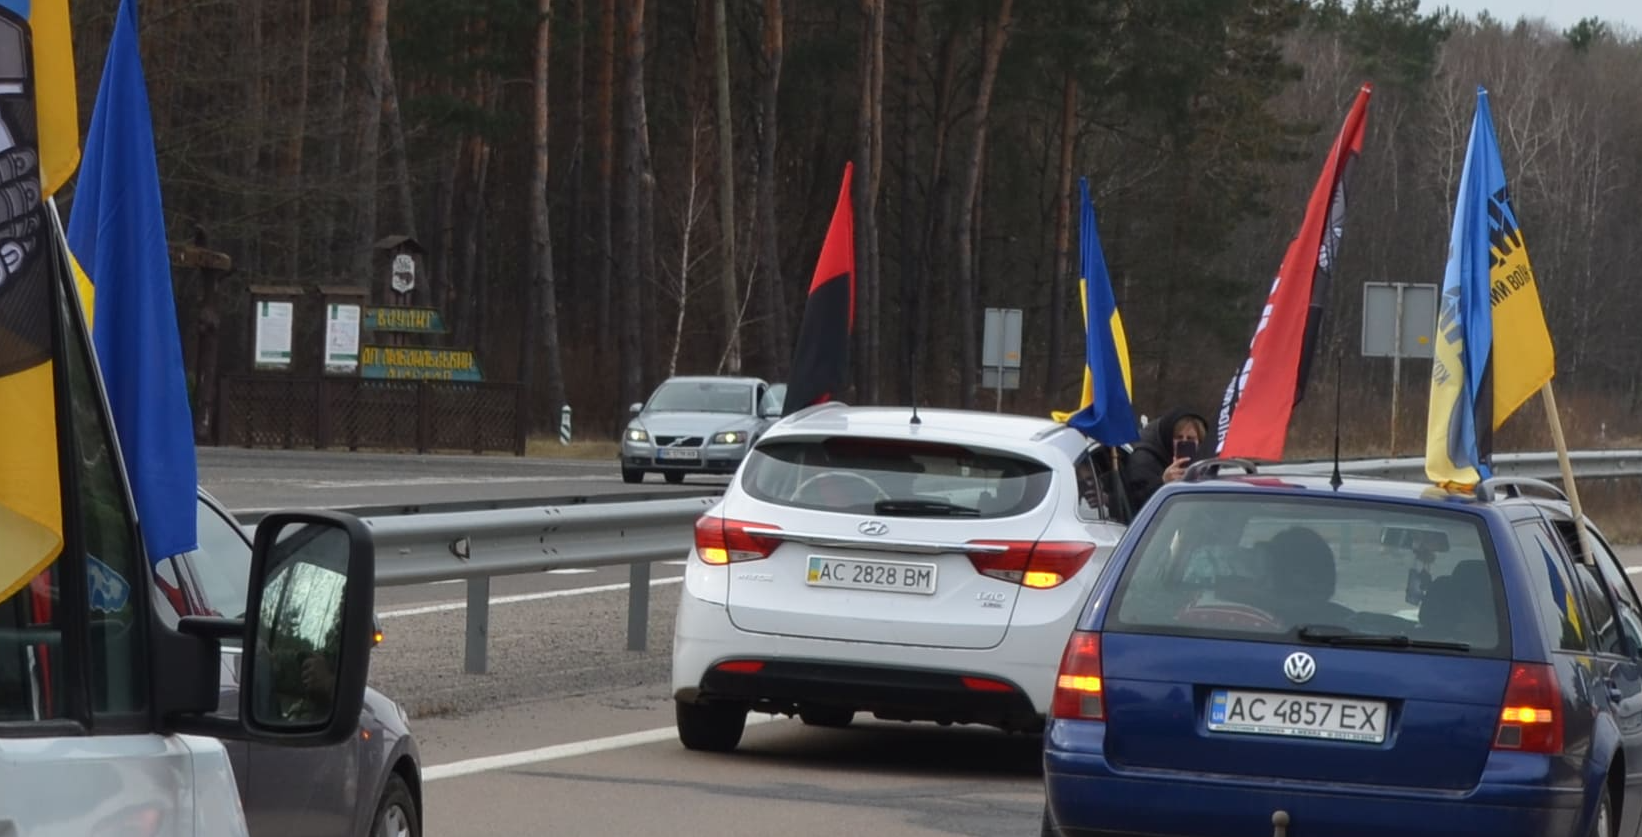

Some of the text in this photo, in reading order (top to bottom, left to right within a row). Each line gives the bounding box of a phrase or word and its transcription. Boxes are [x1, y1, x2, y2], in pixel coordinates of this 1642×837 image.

[820, 562, 846, 581] AC
[852, 564, 897, 585] 2828
[903, 567, 931, 588] BM
[1228, 696, 1379, 732] AC 4857 EX
